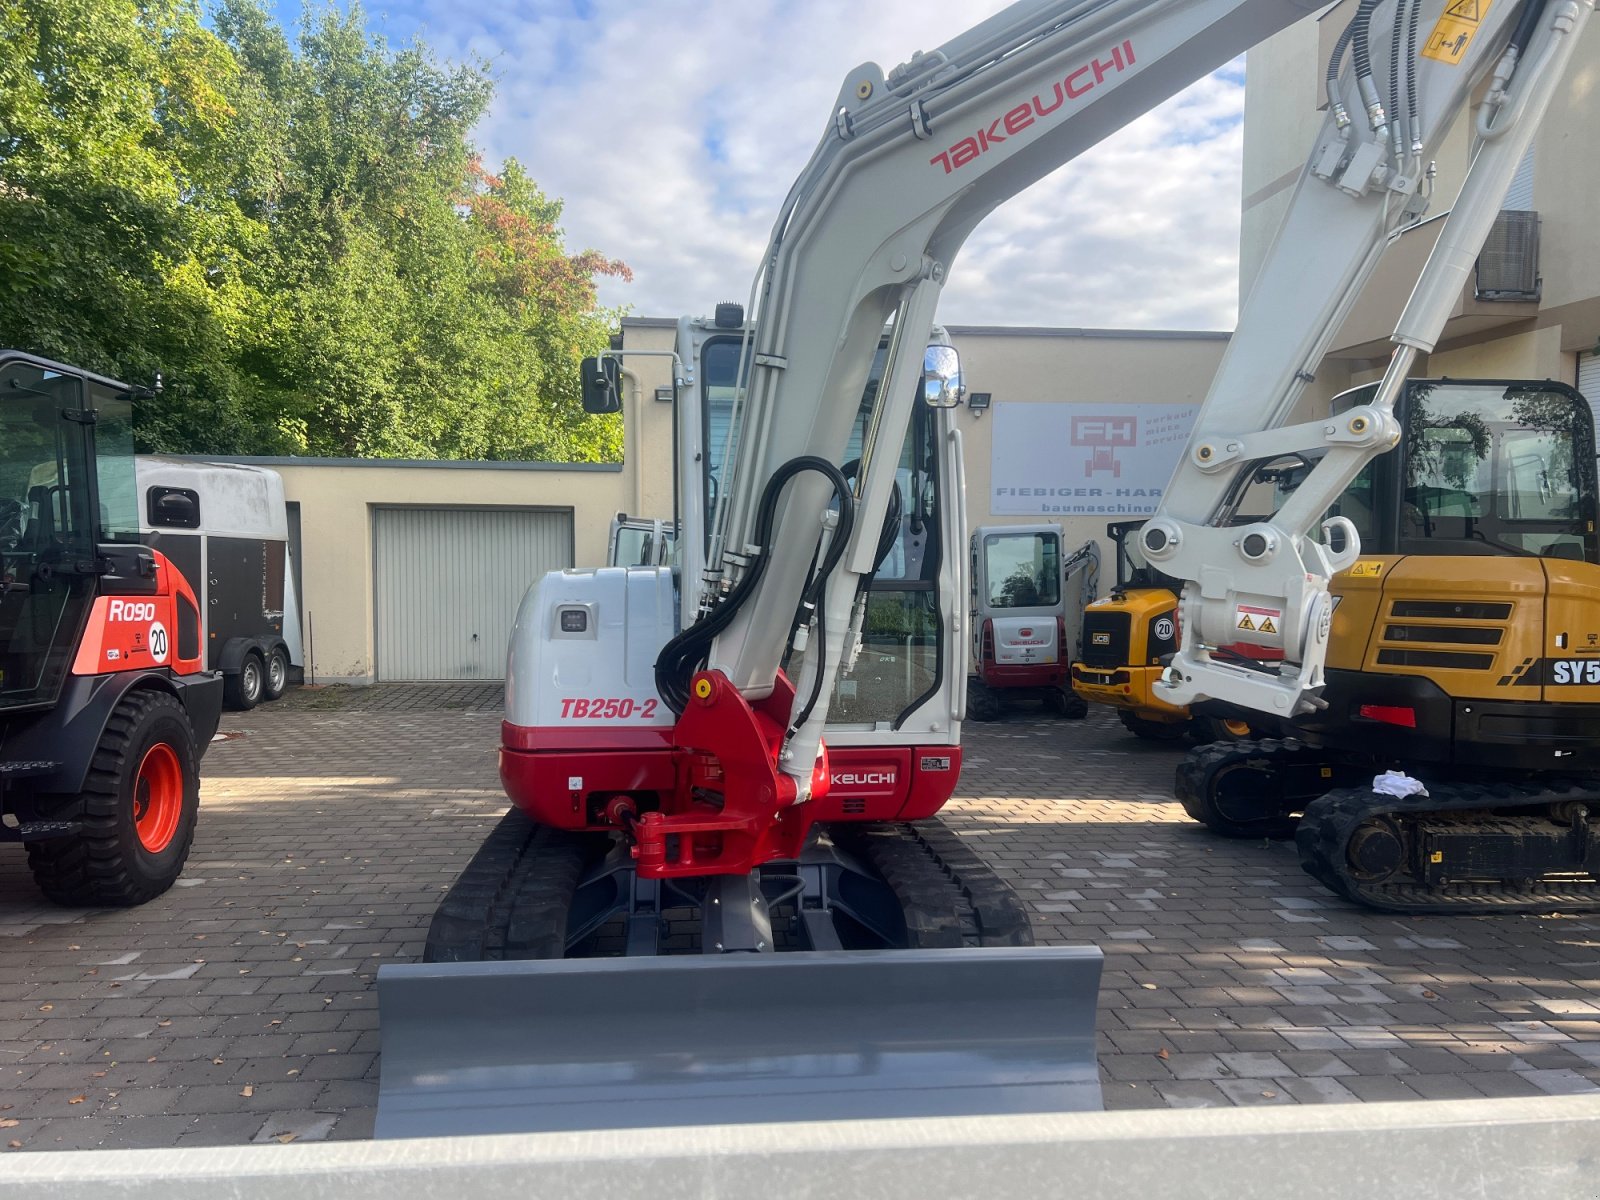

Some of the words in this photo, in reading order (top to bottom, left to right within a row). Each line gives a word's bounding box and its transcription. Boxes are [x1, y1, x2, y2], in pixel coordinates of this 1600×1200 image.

[929, 39, 1136, 175] TAKEUCHI
[1094, 634, 1110, 643] JCB
[1158, 623, 1170, 635] 20
[151, 629, 166, 656] 20
[1553, 661, 1600, 684] SY5
[560, 698, 658, 719] TB250-2
[830, 773, 896, 785] KEUCHI
